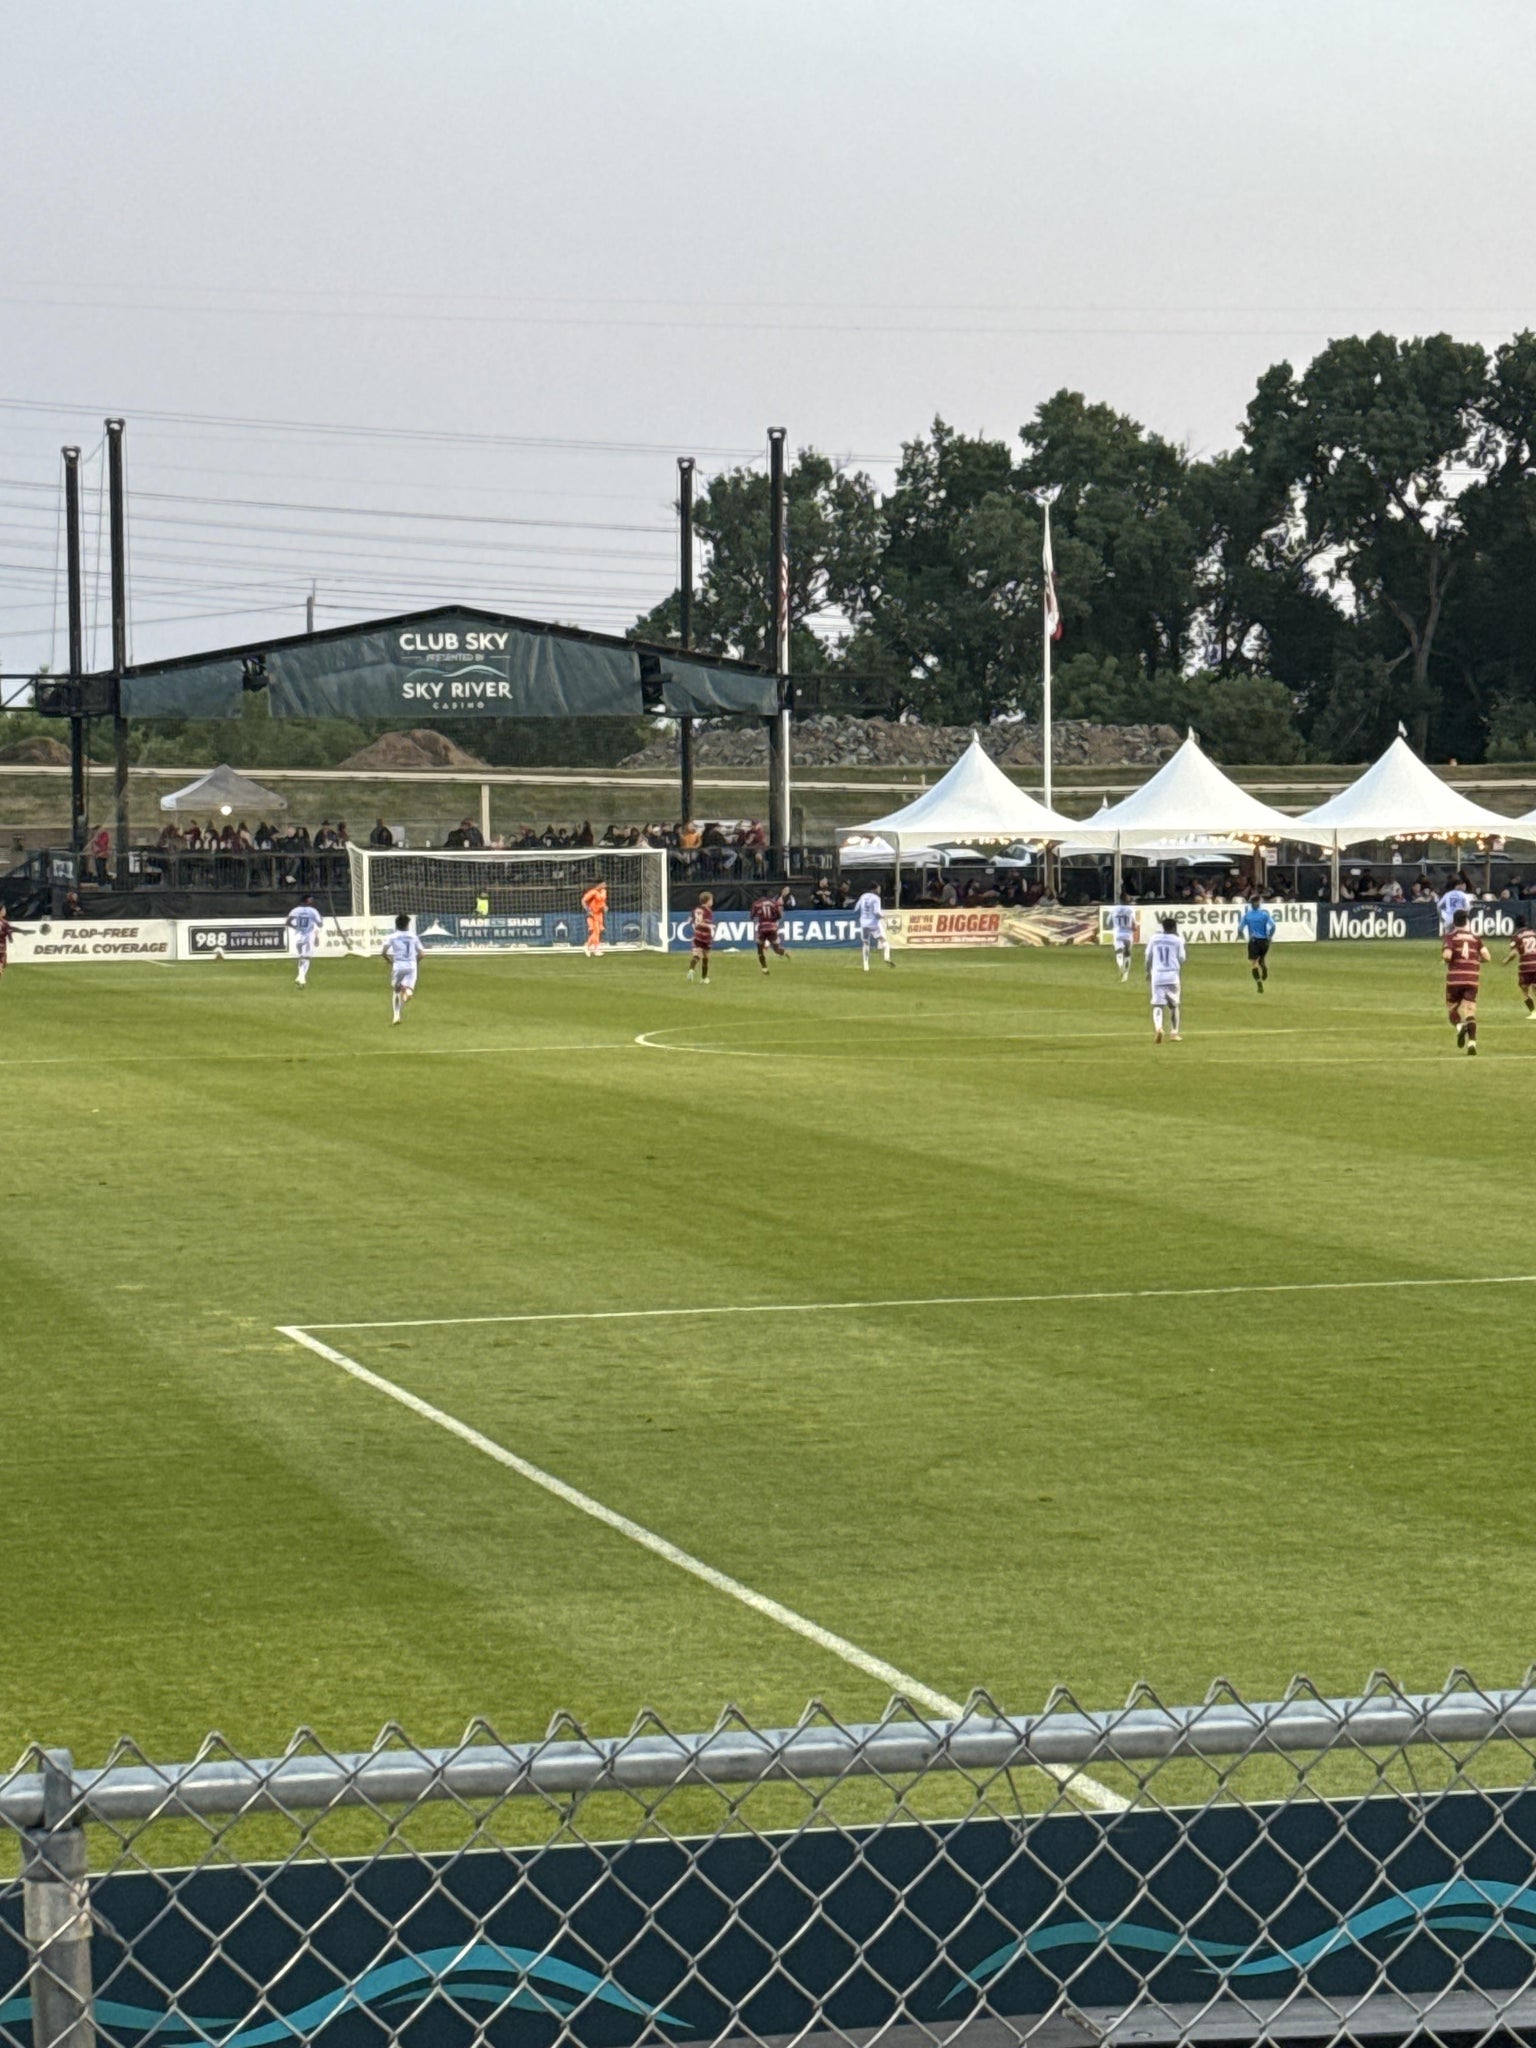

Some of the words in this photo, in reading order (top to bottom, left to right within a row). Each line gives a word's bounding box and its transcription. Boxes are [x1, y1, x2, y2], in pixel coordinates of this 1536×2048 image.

[399, 633, 459, 650] CLUB
[465, 632, 509, 650] SKY
[402, 682, 444, 699] SKY
[451, 682, 513, 699] RIVER
[432, 701, 485, 710] CASINO
[936, 914, 999, 932] BIGGER
[1329, 910, 1407, 938] Modelo
[62, 928, 139, 939] FLOP-FREE
[460, 929, 488, 937] TENT
[494, 928, 542, 937] RENTALS
[195, 932, 227, 947] 988
[230, 937, 279, 947] LIFELINE
[33, 944, 89, 955] DENTAL
[92, 943, 168, 953] COVERAGE
